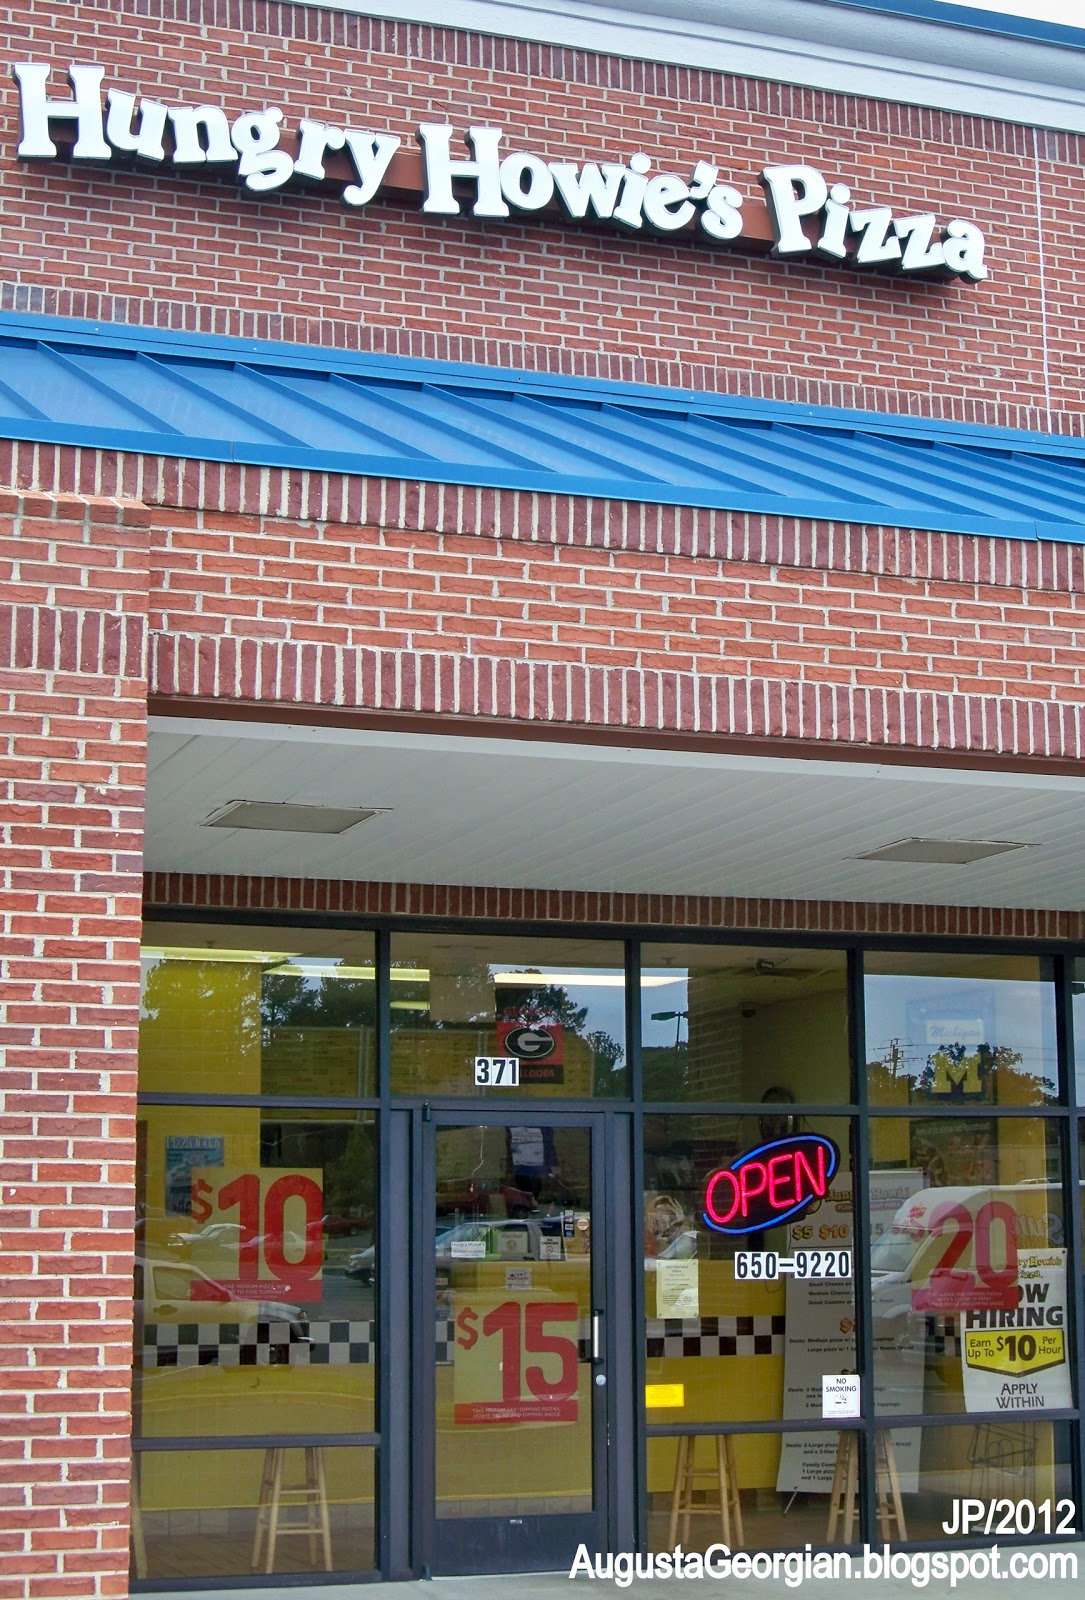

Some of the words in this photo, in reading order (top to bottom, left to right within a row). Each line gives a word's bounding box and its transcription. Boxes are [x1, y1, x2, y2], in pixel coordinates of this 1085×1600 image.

[14, 61, 402, 206] Hungry
[417, 122, 744, 240] Howie's
[760, 162, 989, 284] Pizza
[476, 1058, 517, 1085] 371
[931, 1051, 982, 1093] M
[706, 1146, 826, 1223] OPEN
[191, 1174, 324, 1280] $10
[792, 1225, 813, 1241] $5
[819, 1224, 849, 1240] $10
[736, 1252, 850, 1278] 650-9220
[966, 1306, 1063, 1329] HIRING
[970, 1339, 991, 1347] Earn
[997, 1334, 1036, 1362] $10
[1038, 1345, 1061, 1355] Hour
[1042, 1336, 1057, 1344] Per
[457, 1302, 578, 1402] $15
[967, 1349, 981, 1359] Up
[982, 1348, 995, 1357] To
[836, 1377, 847, 1385] NO
[1001, 1383, 1038, 1395] APPLY
[996, 1396, 1045, 1409] WITHIN
